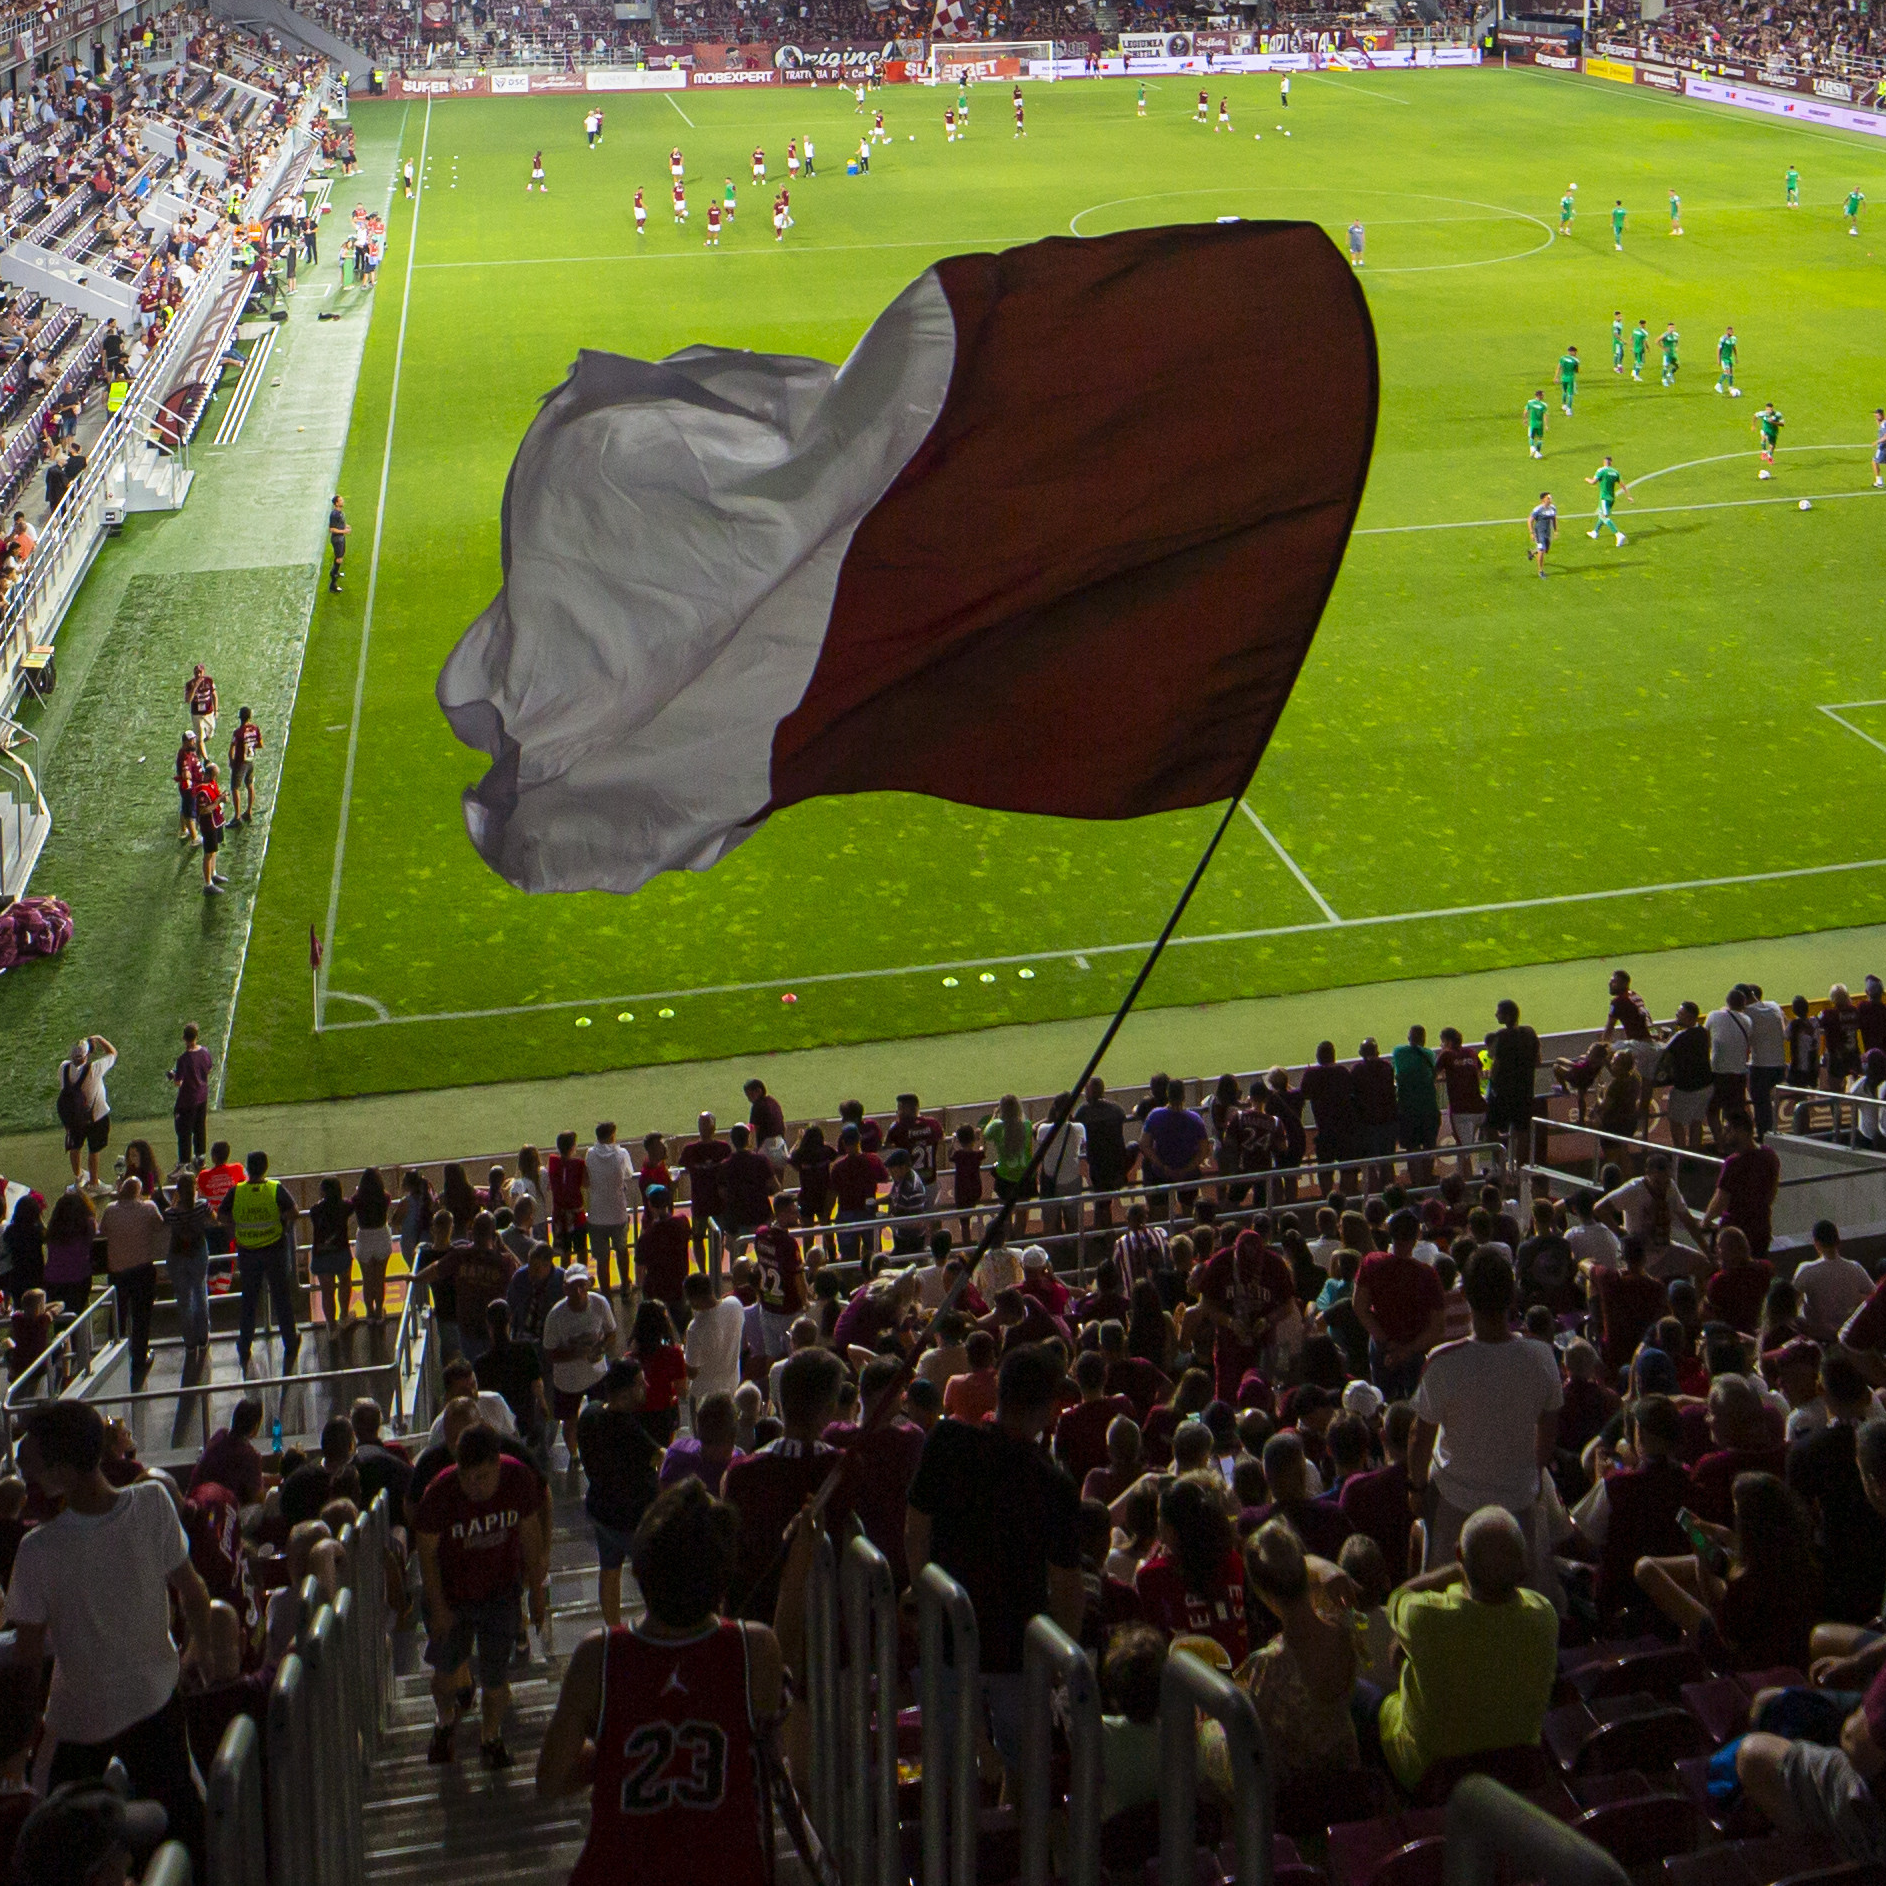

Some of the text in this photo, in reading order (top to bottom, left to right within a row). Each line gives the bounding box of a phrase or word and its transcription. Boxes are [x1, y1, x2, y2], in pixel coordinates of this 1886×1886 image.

[508, 77, 527, 88] DSC
[693, 71, 775, 86] MOBEXPERT
[1813, 78, 1853, 98] TARSIN
[911, 1144, 935, 1171] 21
[451, 1509, 519, 1539] RAPID
[619, 1719, 729, 1816] 23
